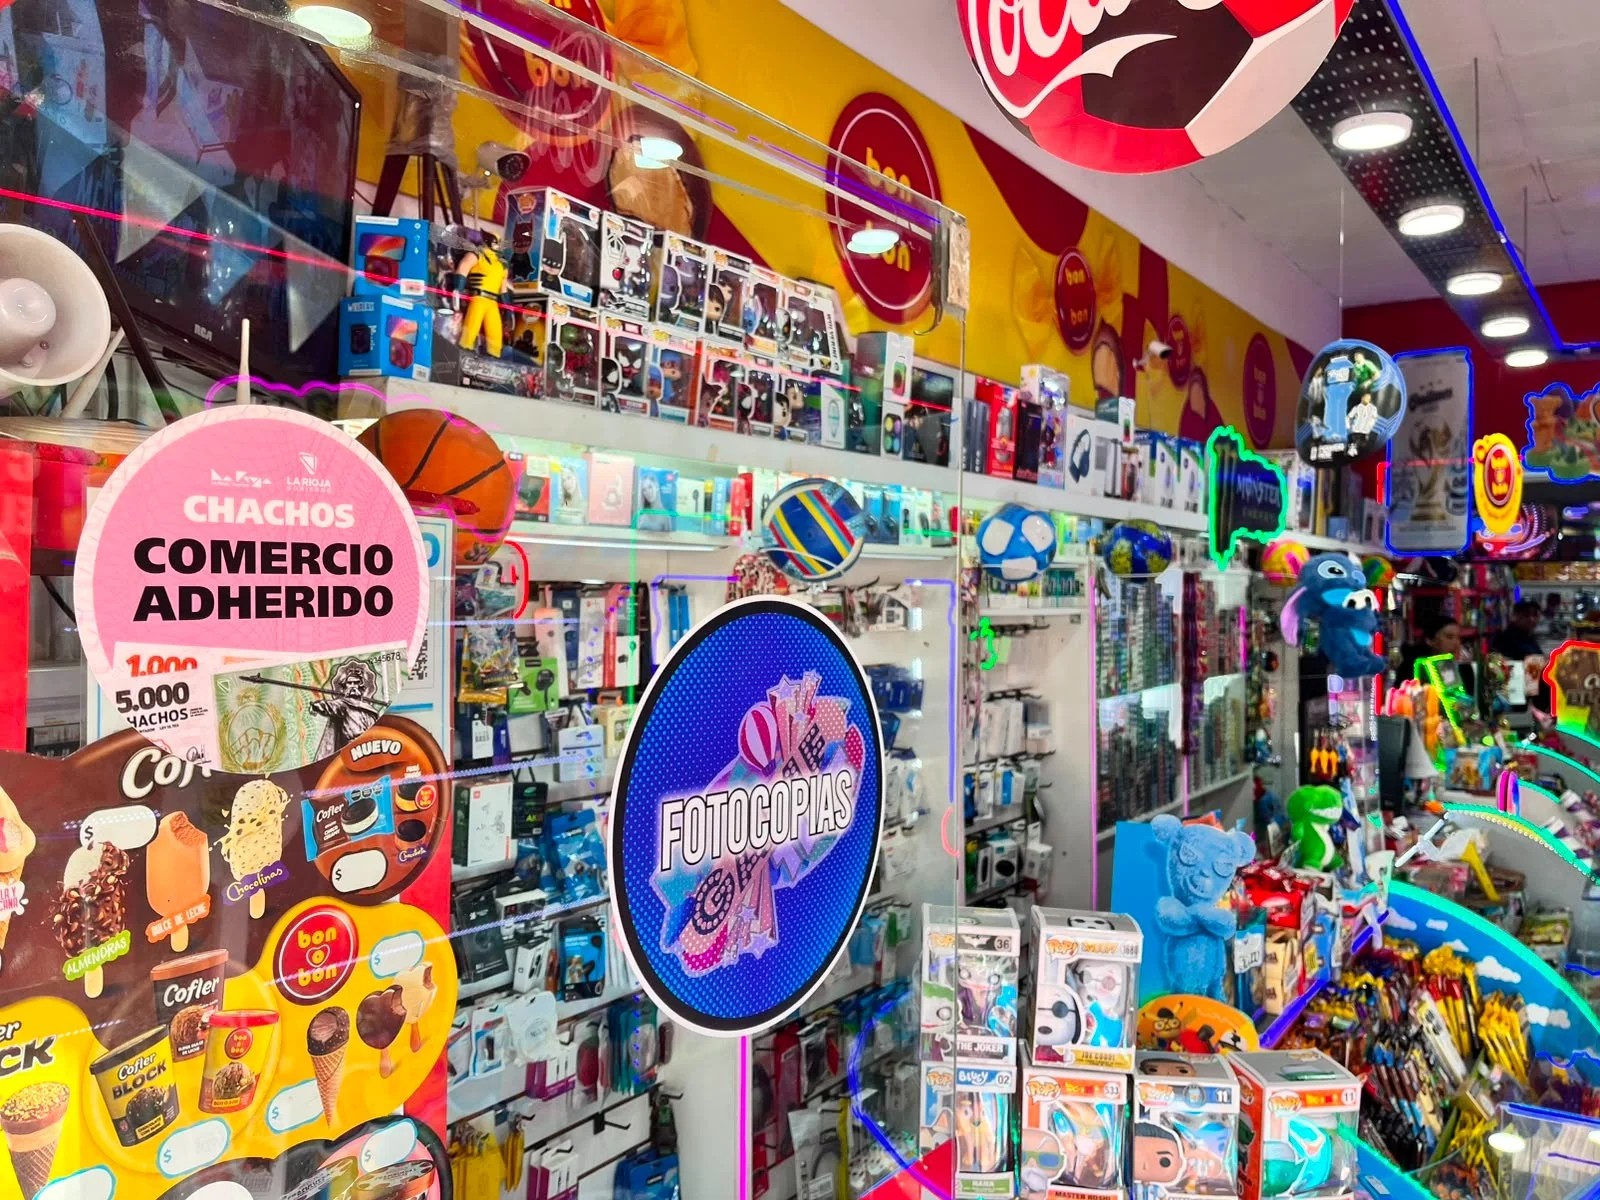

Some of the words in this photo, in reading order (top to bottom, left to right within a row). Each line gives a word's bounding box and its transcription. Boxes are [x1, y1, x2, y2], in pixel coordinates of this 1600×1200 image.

[183, 495, 356, 529] CHACHOS
[133, 537, 394, 576] COMERCIO
[133, 585, 393, 622] ADHERIDO
[115, 682, 190, 714] 5.000
[350, 739, 402, 762] NUEVO
[316, 803, 344, 823] Cofler
[660, 769, 853, 872] FOTOCOPIAS
[227, 868, 283, 901] Chocolinas
[298, 927, 337, 949] bon
[996, 939, 1010, 949] 36
[67, 937, 127, 973] ALMENDRAS
[312, 950, 325, 964] o
[298, 964, 337, 987] bon
[163, 976, 220, 1007] Cofler
[956, 1042, 973, 1051] THE
[975, 1042, 1004, 1053] JOKER
[118, 1053, 157, 1081] Cofler
[998, 1075, 1010, 1084] 02
[112, 1062, 167, 1100] BLOCK
[1216, 1088, 1229, 1102] 11
[1344, 1092, 1355, 1102] 11
